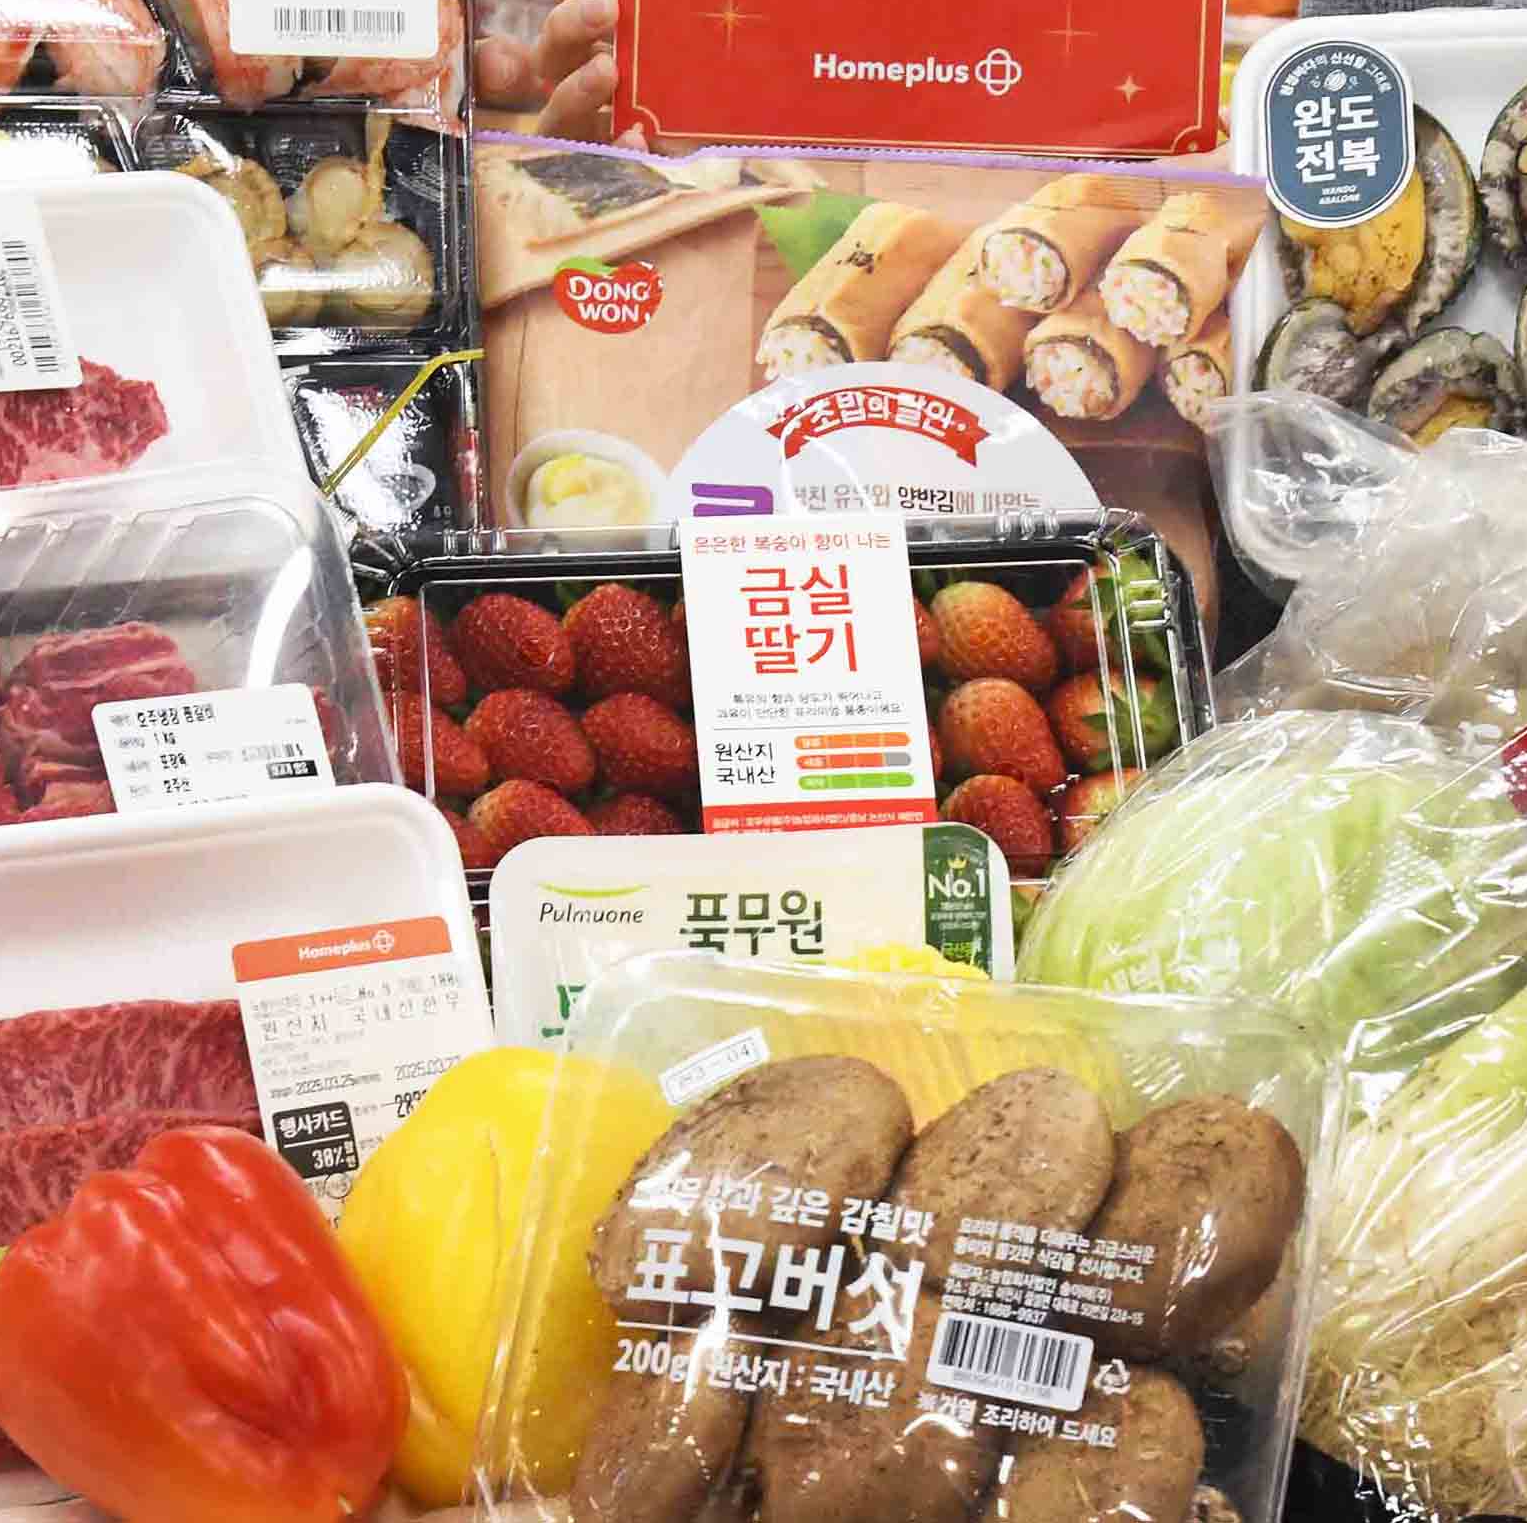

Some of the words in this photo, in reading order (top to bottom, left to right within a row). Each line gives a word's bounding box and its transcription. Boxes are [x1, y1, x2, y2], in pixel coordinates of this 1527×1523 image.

[813, 52, 970, 86] Homeplus
[1293, 95, 1379, 140] 완도
[1295, 137, 1381, 183] 전복
[570, 274, 650, 303] DONG
[576, 302, 643, 324] WON
[693, 535, 746, 555] 은은한
[754, 534, 806, 553] 복숭아
[814, 533, 850, 551] 향이
[857, 532, 891, 549] 나는
[740, 564, 854, 616] 금실
[745, 621, 857, 674] 딸기
[714, 742, 774, 762] 원산지
[715, 766, 777, 785] 국내산
[927, 867, 986, 901] No.1
[539, 902, 644, 925] Pulmuone
[680, 889, 825, 955] 풀무원
[298, 940, 372, 960] Homeplus
[769, 1187, 831, 1228] 깊은
[841, 1198, 934, 1247] 감칠맛
[626, 1228, 925, 1362] 표고버섯
[613, 1340, 690, 1382] 200g
[707, 1354, 791, 1397] 원산지
[811, 1365, 895, 1407] 국내산
[980, 1404, 1056, 1438] 조리하여
[1062, 1419, 1117, 1449] 드세요
